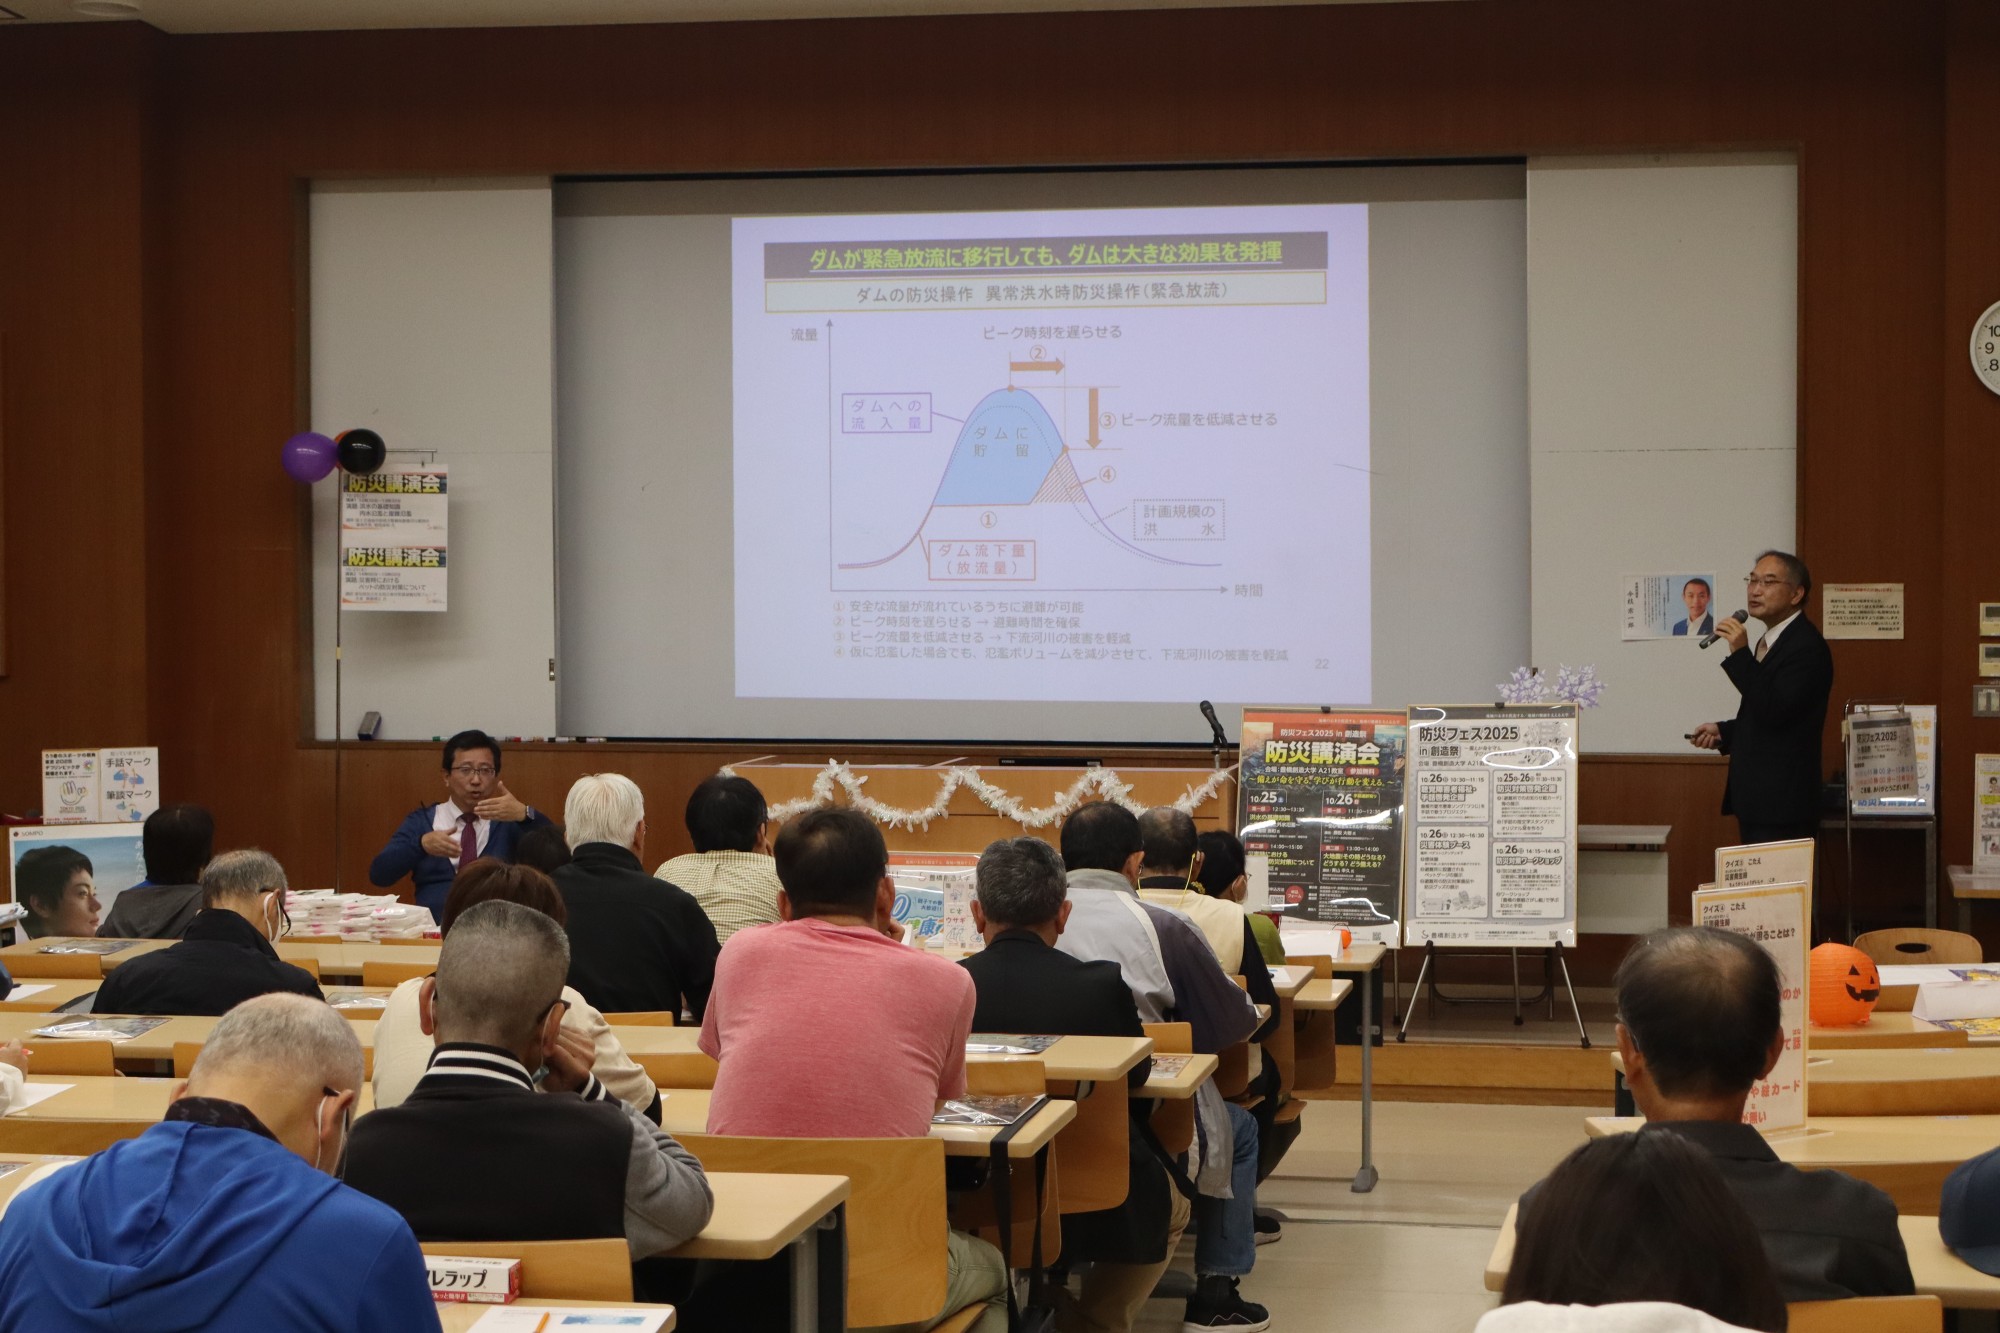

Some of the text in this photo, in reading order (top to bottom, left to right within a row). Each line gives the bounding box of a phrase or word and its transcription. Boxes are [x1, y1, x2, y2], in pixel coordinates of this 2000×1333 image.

[810, 240, 1283, 270] ダムが緊急放流に移行しても、ダムは大きな効果を発揮
[857, 286, 973, 303] ダムの防災操作
[791, 328, 818, 342] 流量
[983, 325, 1122, 340] ピーク時刻を遅らせる
[1989, 325, 2000, 337] 10
[1029, 345, 1047, 362] ②
[1985, 342, 1994, 354] 9
[1989, 359, 1999, 371] 8
[852, 400, 922, 413] ダムへの
[1122, 412, 1279, 427] ピーク流量を低減させる
[974, 427, 1029, 440] ダムに
[1099, 466, 1116, 483] ④
[349, 474, 440, 492] 防災講演会
[1143, 504, 1215, 518] 計画規模の
[980, 511, 997, 528] ①
[349, 548, 440, 566] 防災講演会
[938, 544, 1026, 557] ダム流下量
[1234, 584, 1263, 597] 時間
[851, 600, 1085, 613] 安全な流量が流れているうちに避難が可能
[851, 616, 972, 628] ピーク時刻を遅らせる
[993, 616, 1081, 629] 避難時間を確保
[851, 631, 984, 644] ピーク流量を低減させる
[1006, 632, 1132, 645] 下流河川の被害を軽減
[1315, 658, 1329, 670] 22
[1280, 729, 1334, 737] 防災フェス2025
[1419, 727, 1518, 742] 防災フェス2025
[1265, 740, 1380, 766] 防災講演会
[1419, 746, 1427, 756] in
[1430, 746, 1459, 757] 創造祭
[105, 757, 151, 767] 手話マーク
[106, 790, 152, 800] 筆談マーク
[1250, 791, 1277, 803] 10/25
[1325, 793, 1353, 805] 10/26
[1748, 857, 1762, 866] こたえ
[1730, 902, 1746, 911] こたえ
[1751, 1080, 1800, 1098] や絵カード
[427, 1269, 487, 1288] レラップ
